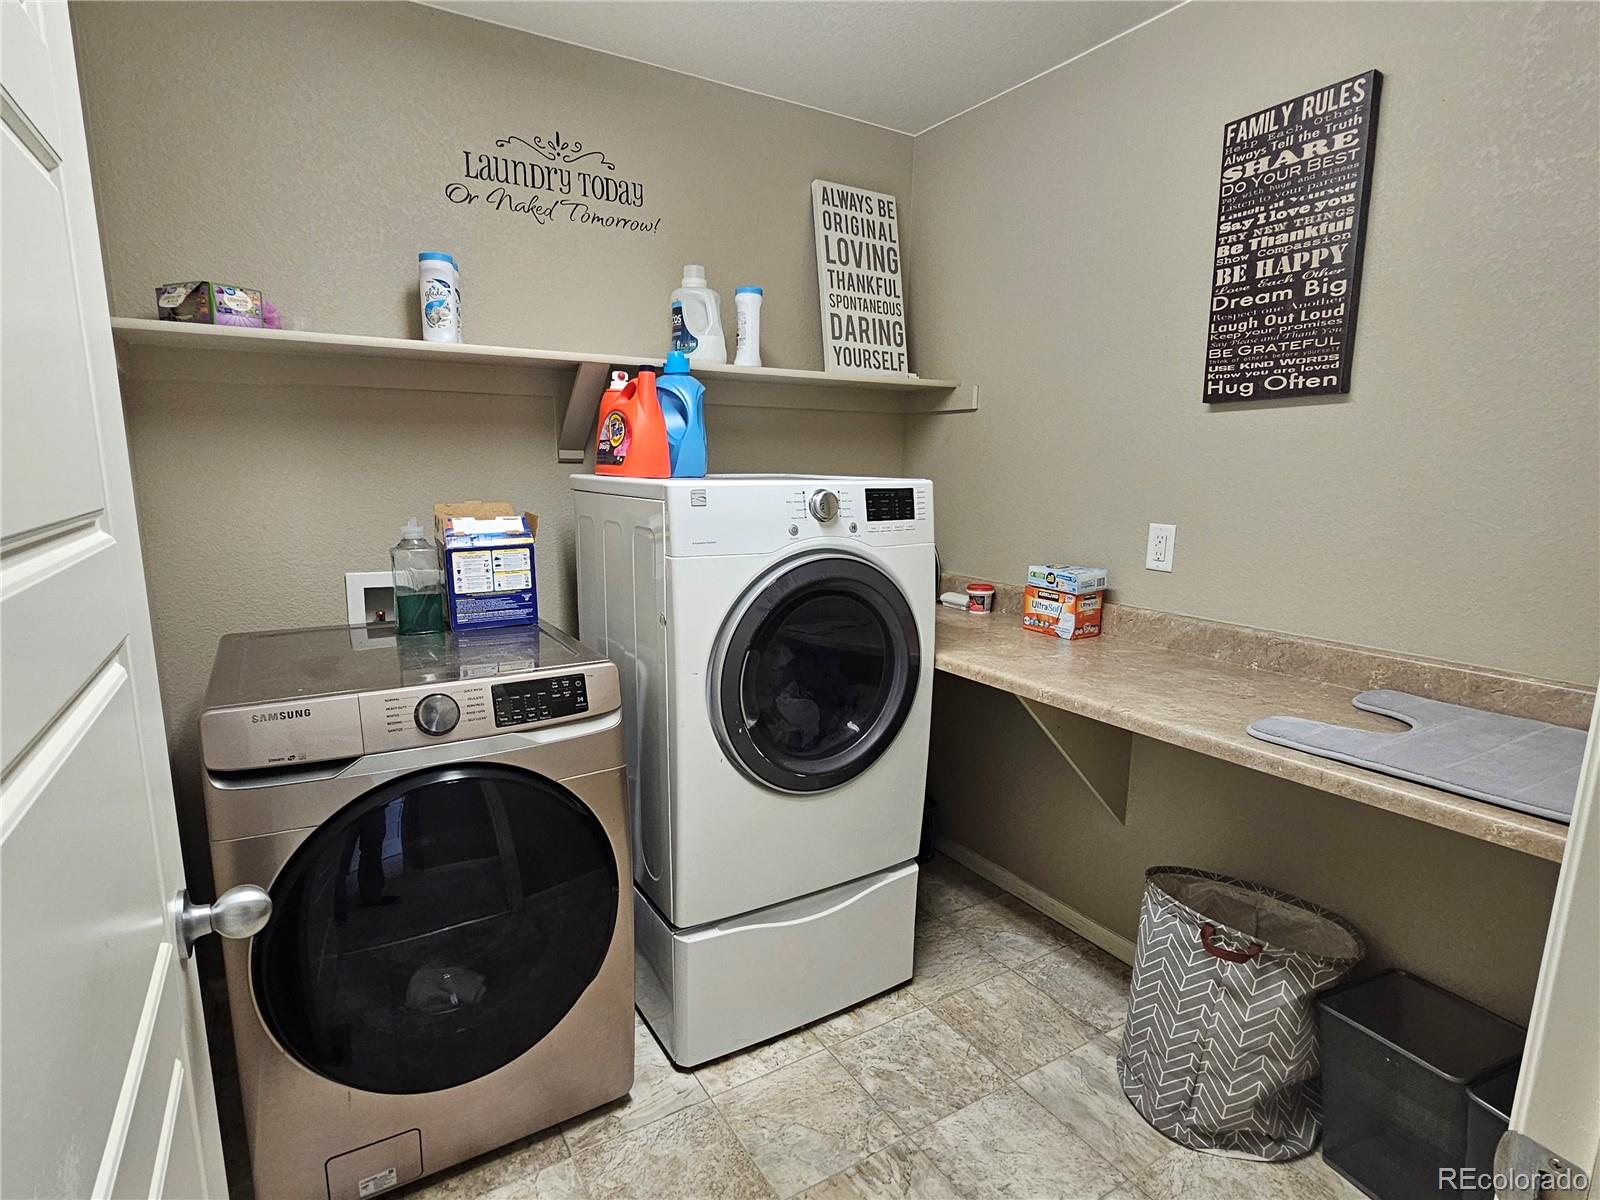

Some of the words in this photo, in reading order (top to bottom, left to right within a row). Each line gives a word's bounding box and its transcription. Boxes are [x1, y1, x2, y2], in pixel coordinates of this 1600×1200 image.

[1226, 102, 1294, 147] FAMILY
[1301, 78, 1366, 121] RULES
[1224, 147, 1267, 167] Always
[1271, 134, 1294, 151] Tell
[1298, 130, 1320, 142] the
[1325, 114, 1362, 134] Truth
[1225, 140, 1258, 156] Help
[1268, 124, 1303, 141] Each
[1314, 104, 1364, 125] Other
[1222, 129, 1360, 183] SHARE
[1222, 181, 1247, 197] DO
[1251, 165, 1301, 187] YOUR
[1307, 147, 1361, 172] BEST
[1221, 199, 1255, 213] Listen
[1259, 195, 1271, 203] to
[1275, 186, 1304, 200] your
[1308, 173, 1358, 192] parents
[1242, 188, 1264, 199] with
[1269, 181, 1291, 192] hugs
[1298, 173, 1316, 183] and
[1322, 162, 1360, 176] kisses
[445, 183, 479, 205] Or
[486, 187, 559, 225] Naked
[560, 200, 662, 234] Tomorrow!
[822, 186, 873, 215] ALWAYS
[878, 199, 895, 220] BE
[1219, 218, 1254, 234] Say
[1257, 212, 1267, 225] I
[1269, 205, 1311, 221] love
[1314, 193, 1355, 212] you
[1220, 206, 1265, 222] Laugh
[1269, 200, 1284, 210] at
[1289, 181, 1357, 204] yourself
[822, 210, 896, 243] ORIGINAL
[1216, 243, 1244, 258] Be
[1248, 215, 1354, 251] Thankful
[1218, 231, 1248, 245] TRY
[1253, 222, 1289, 237] NEW
[1294, 206, 1355, 227] THINGS
[824, 235, 899, 275] LOVING
[1257, 232, 1351, 257] Compassion
[1215, 264, 1247, 287] BE
[1255, 243, 1348, 279] HAPPY
[1215, 285, 1250, 296] Love
[1257, 274, 1295, 287] Each
[1302, 267, 1346, 280] Other
[827, 268, 901, 299] THANKFUL
[1212, 288, 1293, 312] Dream
[1304, 277, 1347, 297] Big
[829, 293, 902, 317] SPONTANEOUS
[1210, 316, 1258, 333] Laugh
[1264, 312, 1295, 326] Out
[1300, 302, 1345, 321] Loud
[1213, 309, 1257, 321] Respect
[1261, 305, 1284, 314] one
[830, 312, 904, 348] DARING
[1210, 332, 1241, 341] Keep
[1245, 327, 1276, 338] your
[1279, 318, 1343, 334] promises
[1210, 341, 1228, 349] Say
[1230, 337, 1259, 346] Please
[1260, 334, 1280, 342] and
[1283, 328, 1318, 340] Thank
[1321, 326, 1343, 334] You
[833, 345, 905, 372] YOURSELF
[1208, 364, 1236, 372] USE
[1240, 360, 1275, 370] KIND
[1279, 353, 1340, 366] WORDS
[1209, 348, 1233, 359] BE
[1237, 336, 1341, 356] GRATEFUL
[1272, 351, 1299, 359] before
[1303, 345, 1340, 356] yourself
[1207, 371, 1241, 380] Know
[1245, 369, 1269, 378] you
[1301, 360, 1340, 372] loved
[1207, 380, 1254, 397] Hug
[1263, 372, 1338, 391] Often
[1031, 599, 1062, 613] UltraSof
[251, 708, 311, 723] SAMSUNG
